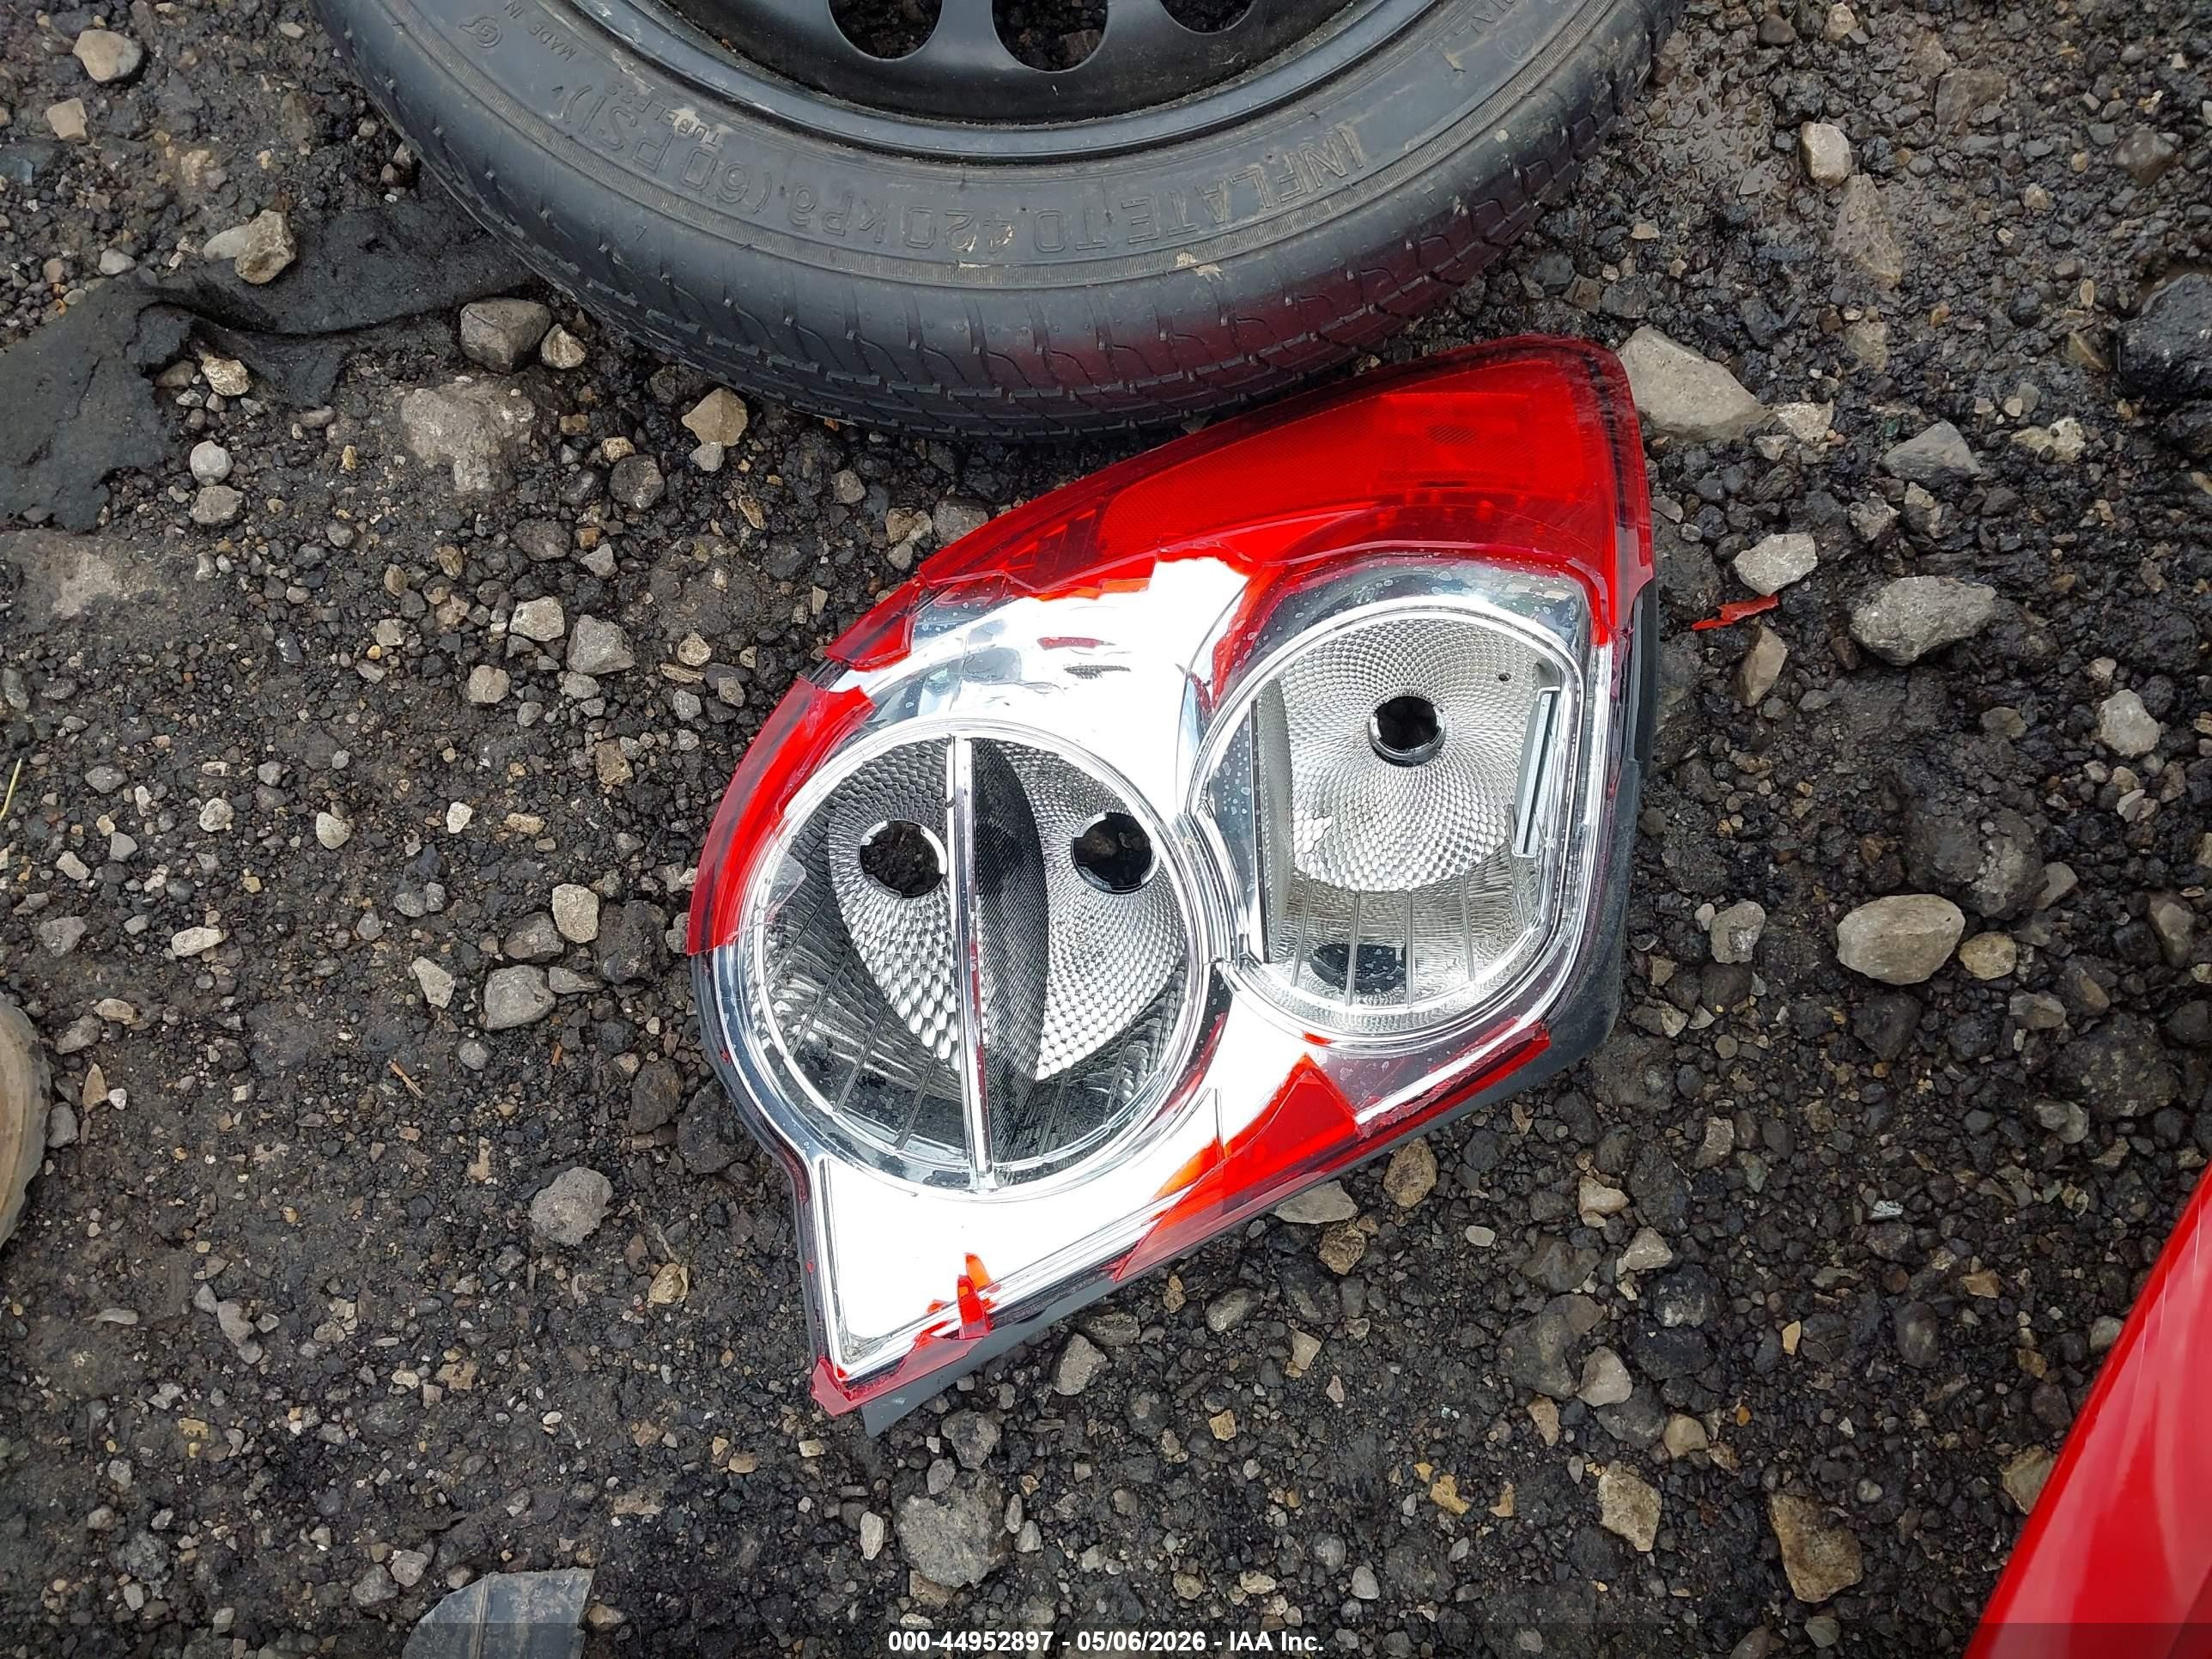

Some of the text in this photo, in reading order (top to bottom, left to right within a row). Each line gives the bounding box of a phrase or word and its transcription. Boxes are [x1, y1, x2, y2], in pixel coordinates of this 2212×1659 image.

[528, 23, 578, 63] MADE
[563, 85, 674, 173] PSI)
[604, 81, 720, 148] TUBELESS
[680, 146, 772, 214] (60
[1121, 126, 1365, 244] INFLATE
[904, 205, 1017, 254] 420
[1033, 205, 1106, 252] TO
